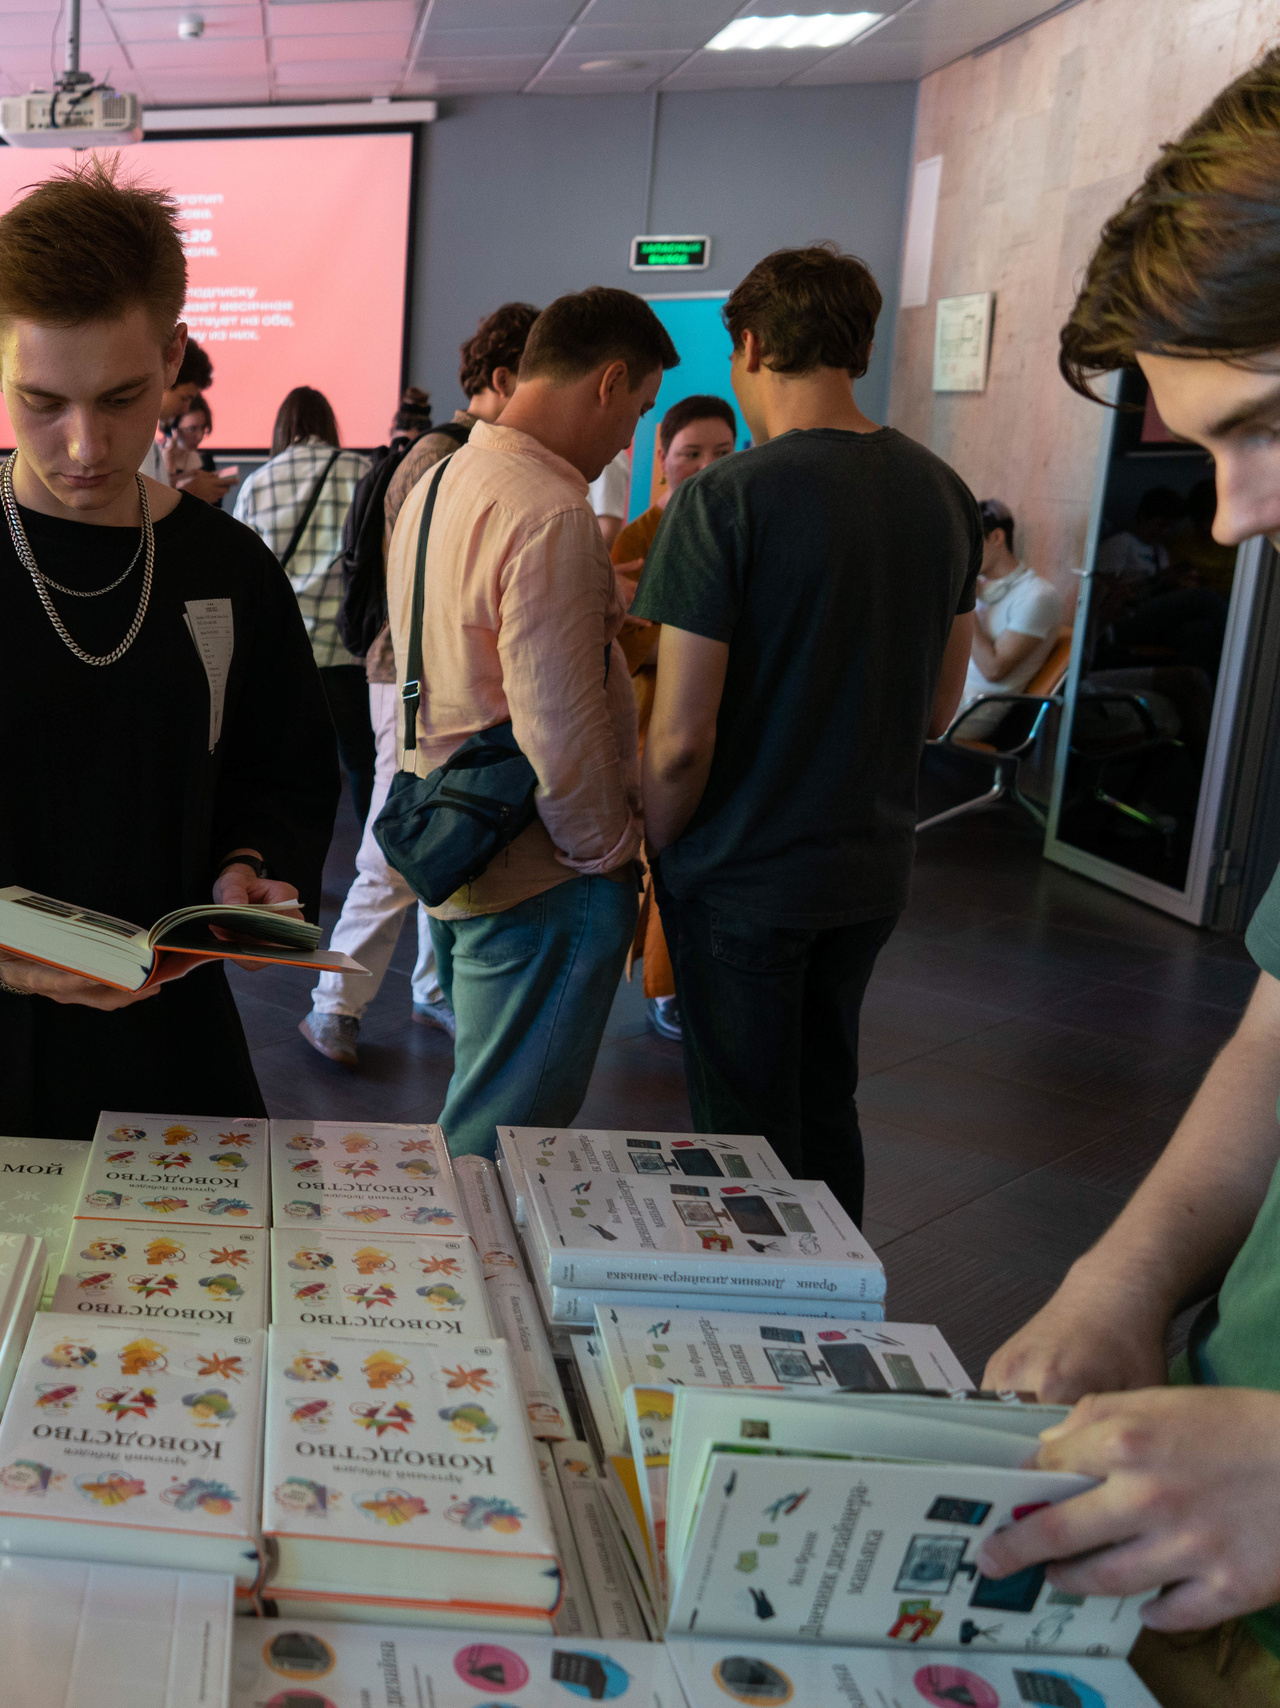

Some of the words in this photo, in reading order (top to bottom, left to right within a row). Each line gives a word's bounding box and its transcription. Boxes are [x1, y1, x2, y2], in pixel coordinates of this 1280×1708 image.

[3, 1162, 65, 1176] мой
[106, 1171, 240, 1190] Ководство
[297, 1180, 436, 1197] Ководство
[616, 1177, 643, 1217] дизайнера-
[642, 1197, 667, 1229] маньяка
[631, 1214, 657, 1249] Дневник
[606, 1270, 730, 1286] дизайнера-маньяка
[730, 1276, 786, 1291] Дневник
[796, 1280, 839, 1292] Франк
[77, 1301, 235, 1325] Ководство
[300, 1312, 463, 1335] Ководство
[698, 1316, 732, 1369] дизайнера-
[729, 1343, 757, 1384] маньяка
[33, 1424, 223, 1460] Ководство
[296, 1441, 496, 1475] Ководство
[798, 1571, 838, 1637] Дневник
[824, 1478, 873, 1572] дизайнера-
[846, 1529, 885, 1595] маньяка
